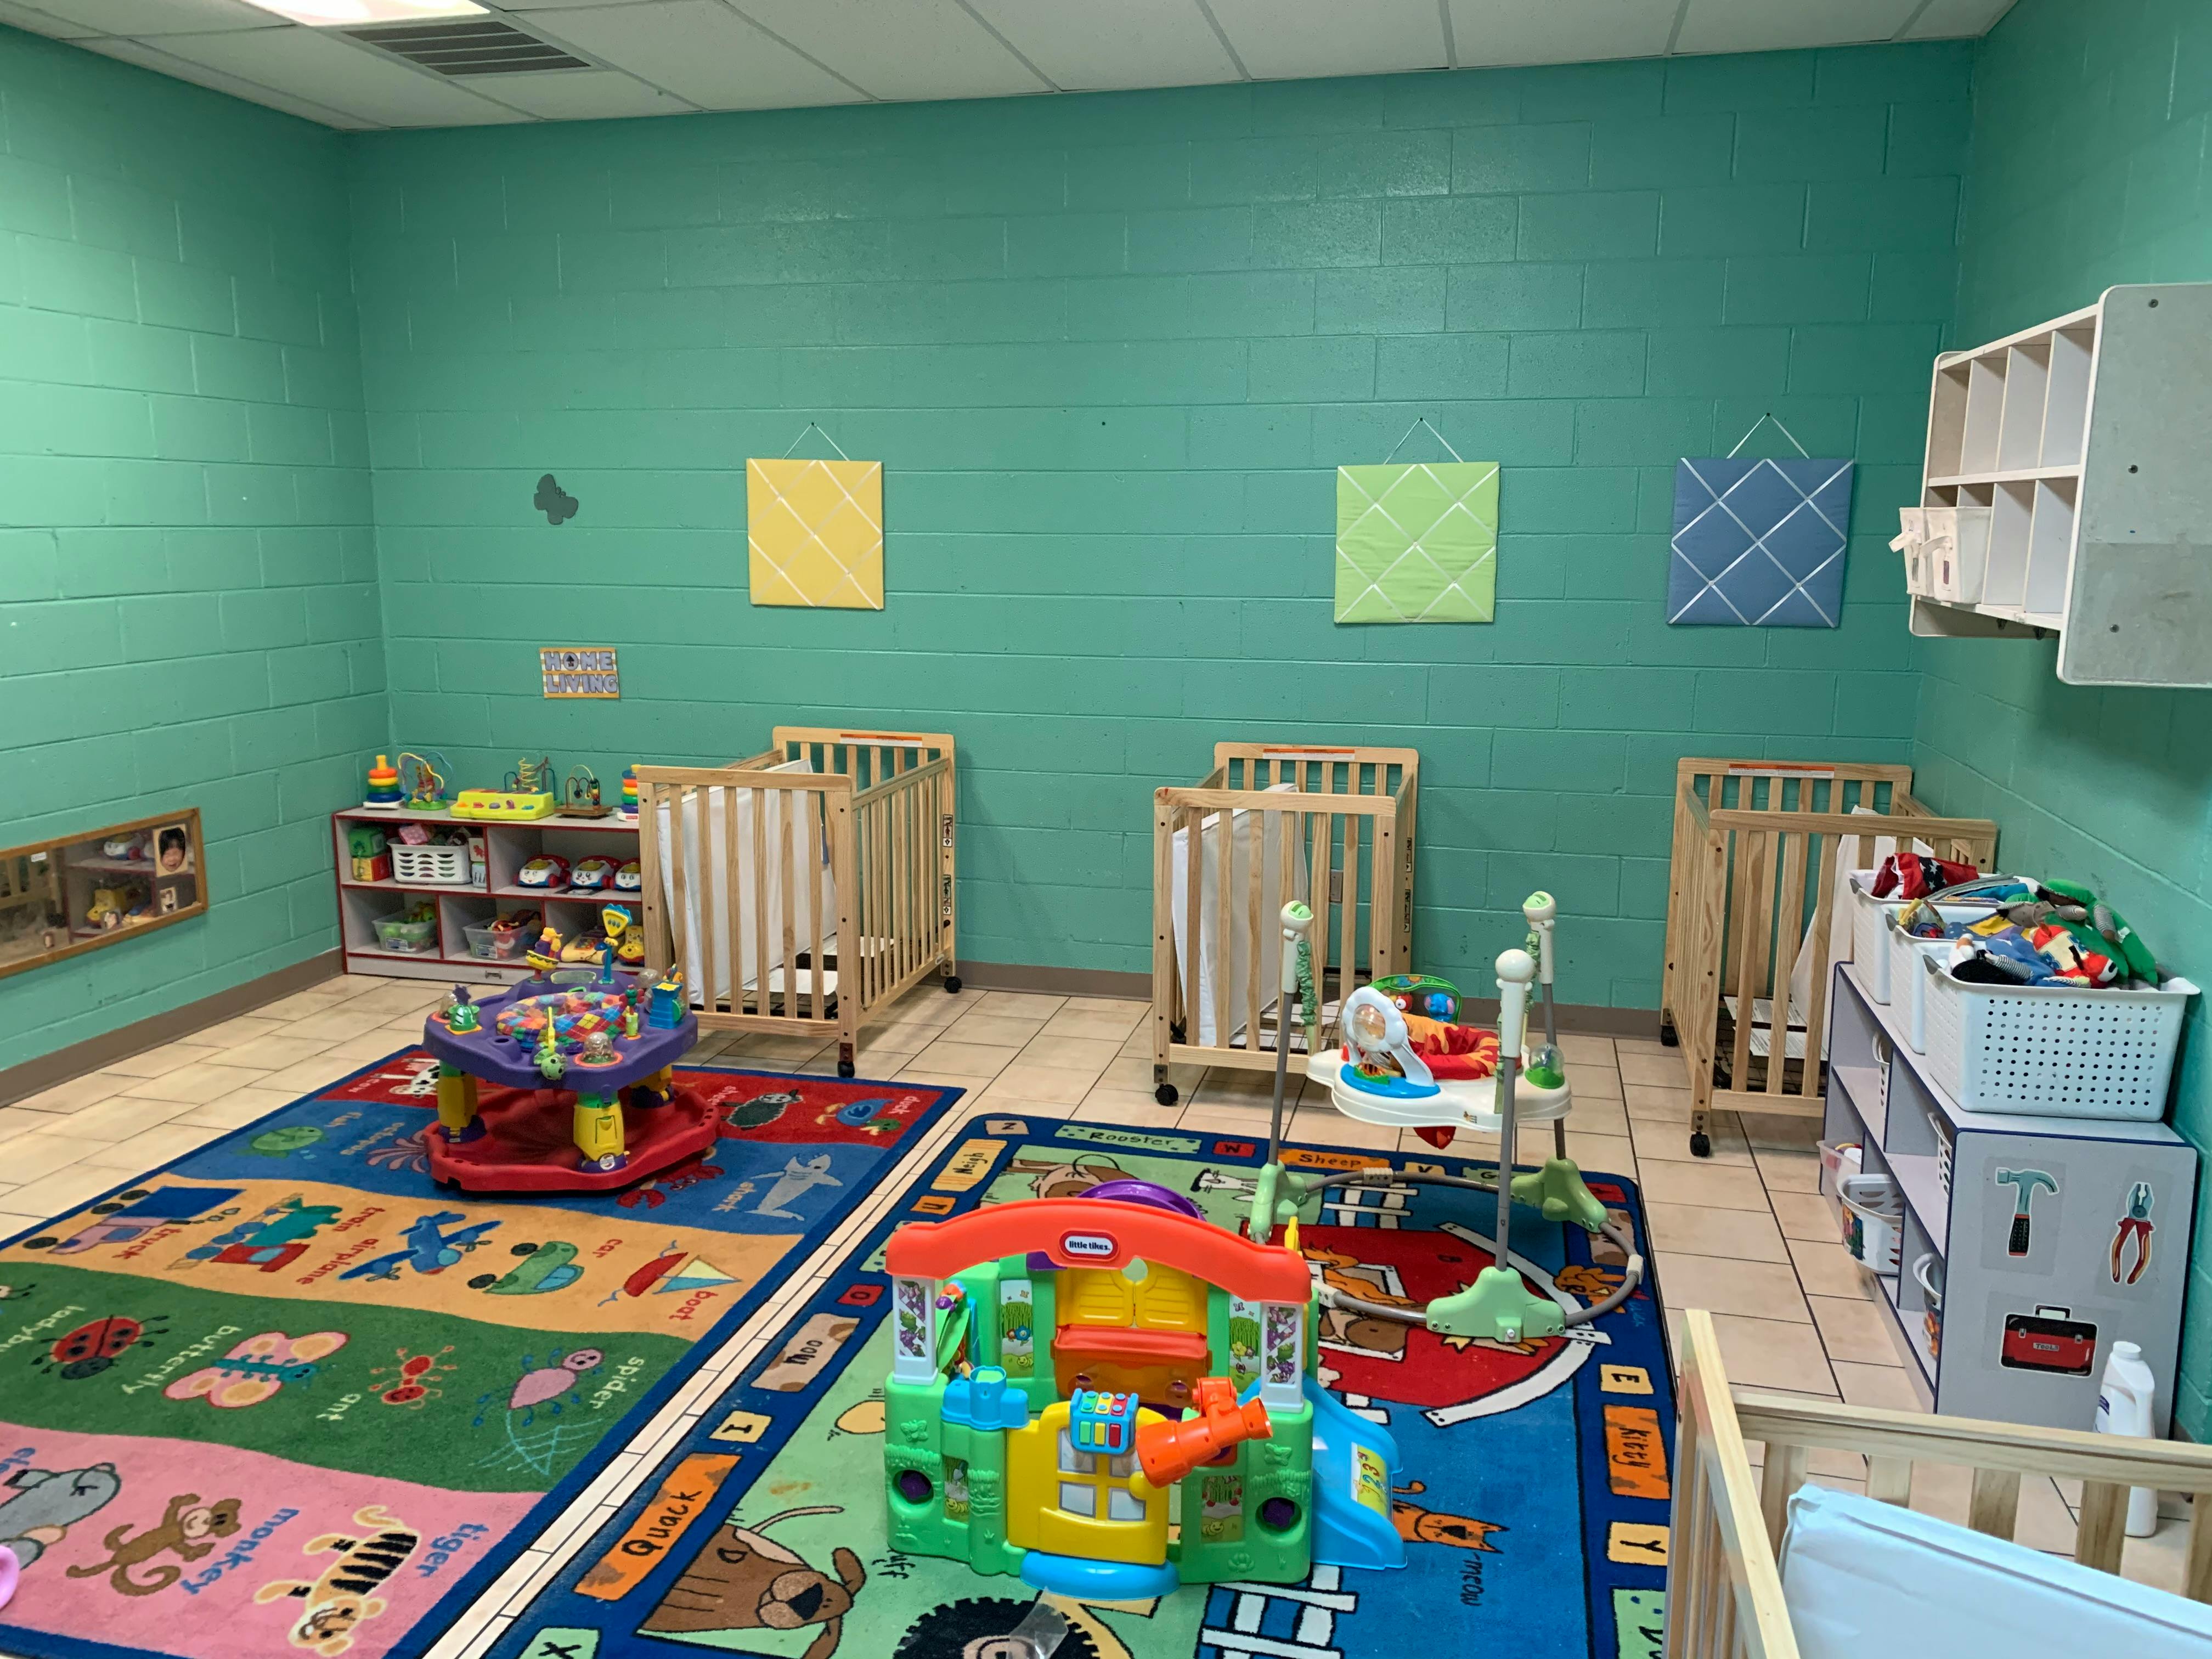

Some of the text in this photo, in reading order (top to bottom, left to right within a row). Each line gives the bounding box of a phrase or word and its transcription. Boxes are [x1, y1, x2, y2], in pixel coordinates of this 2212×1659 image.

[544, 651, 613, 670] HOME
[546, 673, 618, 693] LIVING
[348, 1079, 380, 1092] cow
[888, 1096, 921, 1115] duck
[1089, 1131, 1175, 1146] Rooster
[952, 1152, 988, 1175] Neigh
[712, 1181, 757, 1212] shark
[332, 1207, 386, 1232] train
[112, 1228, 183, 1260] truck
[592, 1239, 623, 1258] car
[296, 1238, 379, 1284] airplane
[669, 1291, 718, 1321] boat
[122, 1325, 242, 1395] butterfly
[589, 1357, 645, 1409] spider
[1611, 1373, 1640, 1383] E
[316, 1393, 361, 1421] ant
[1612, 1427, 1651, 1469] Kitty
[622, 1491, 703, 1556] Quack
[180, 1508, 300, 1595] monkey
[415, 1523, 489, 1577] tiger
[1620, 1540, 1666, 1554] Y
